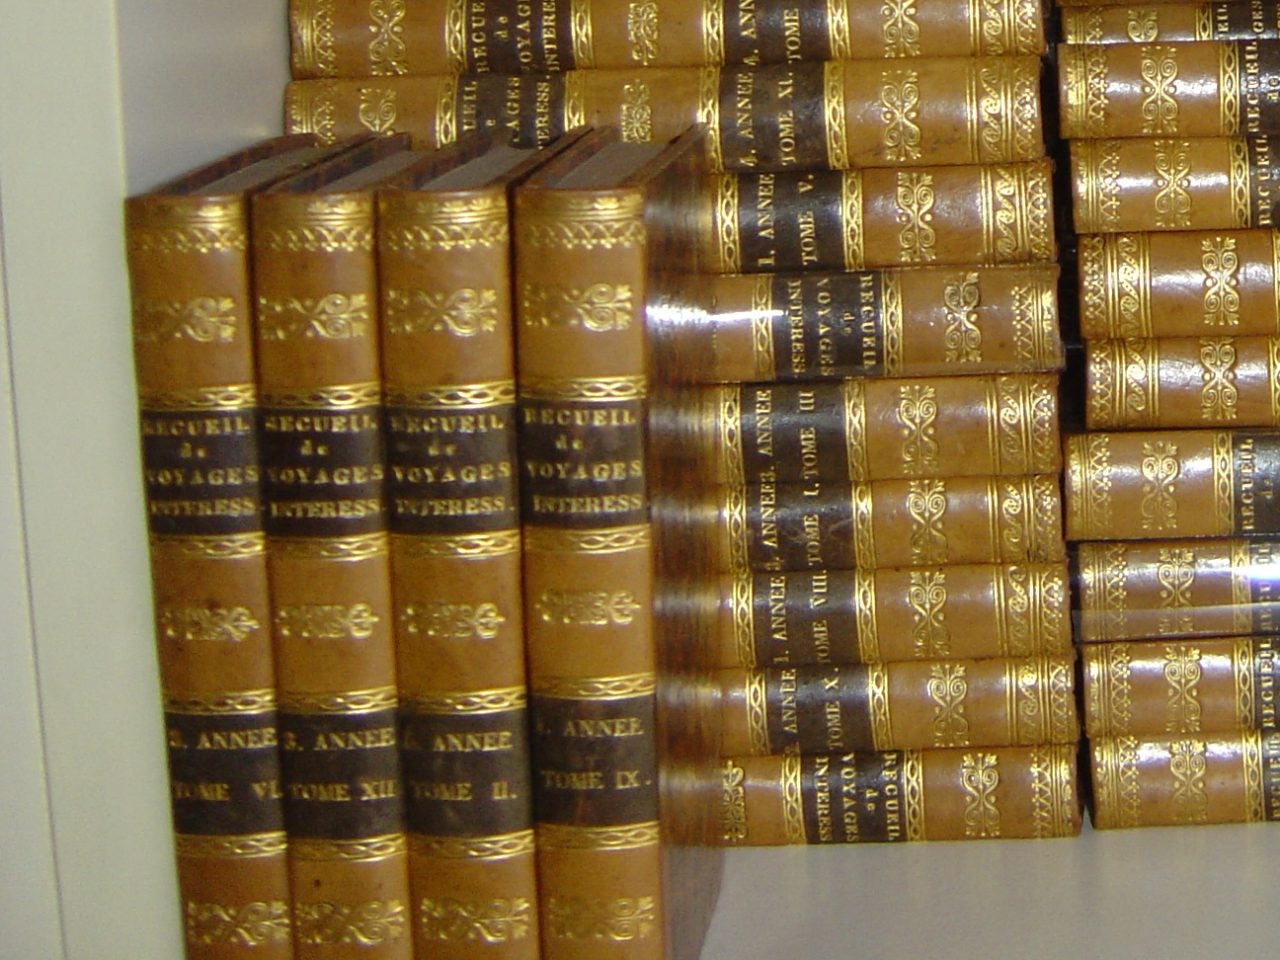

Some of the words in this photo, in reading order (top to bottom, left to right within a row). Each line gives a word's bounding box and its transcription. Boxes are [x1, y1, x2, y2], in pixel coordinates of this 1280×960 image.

[494, 16, 508, 38] de
[783, 8, 802, 63] TOME
[737, 72, 755, 138] ANNEE
[777, 72, 794, 98] XI.
[1245, 41, 1260, 132] RECUEIL
[777, 110, 796, 166] TOME
[757, 173, 775, 239] ANNEE
[798, 174, 814, 193] V.
[1255, 134, 1271, 225] RECUEIL
[797, 211, 817, 266] TOME
[817, 278, 834, 376] VOYAGES
[843, 312, 855, 334] de
[860, 274, 876, 369] RECUEIL
[523, 408, 638, 427] RECUEIL
[756, 389, 772, 456] ANNEE
[393, 461, 511, 483] VOYAGES
[527, 460, 644, 481] VOYAGES
[800, 427, 818, 480] TOME
[1240, 438, 1254, 530] RECUEIL
[760, 483, 778, 548] ANNEE
[803, 514, 822, 566] TOME
[768, 576, 788, 640] ANNEE
[809, 569, 828, 609] VIII.
[780, 668, 798, 734] ANNEE
[1259, 638, 1276, 727] RECUEIL
[197, 727, 278, 750] ANNEE
[314, 728, 396, 750] ANNEE
[433, 731, 513, 753] ANNEE
[563, 718, 644, 738] ANNEE
[825, 701, 843, 750] TOME
[541, 771, 604, 790] TOME
[840, 753, 858, 841] VOYAGES
[865, 789, 879, 811] de
[883, 753, 900, 840] RECUEIL
